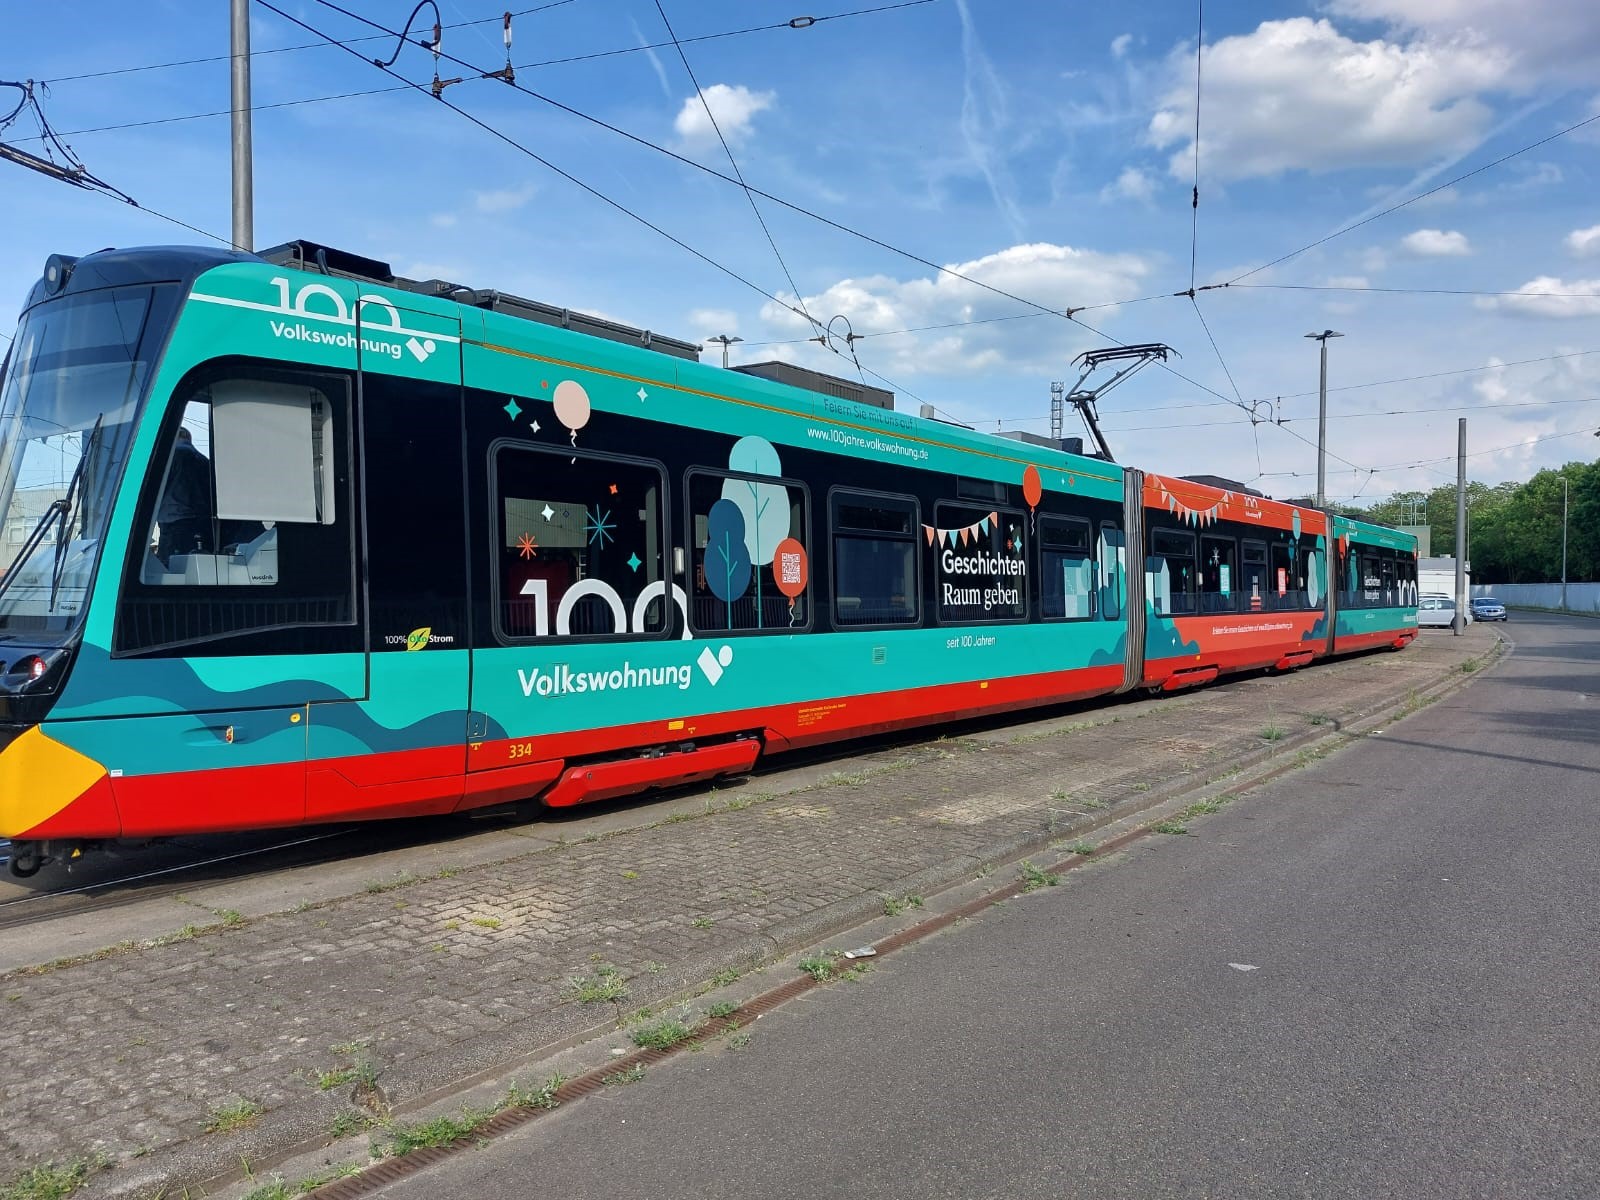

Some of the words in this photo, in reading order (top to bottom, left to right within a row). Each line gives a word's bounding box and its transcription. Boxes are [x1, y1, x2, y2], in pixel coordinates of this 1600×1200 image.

[270, 277, 401, 331] 100
[269, 320, 402, 360] Volkswohnung
[823, 398, 853, 417] Feiern
[853, 404, 867, 420] Sie
[869, 408, 883, 424] mit
[884, 414, 899, 428] uns
[900, 417, 914, 431] auf
[807, 427, 929, 461] www.100jahre.volkswohnung.de
[942, 549, 1026, 577] Geschichten
[519, 578, 694, 641] 100
[942, 582, 982, 606] Raum
[984, 581, 1019, 611] geben
[384, 635, 408, 645] 100%
[946, 635, 960, 649] seit
[961, 635, 973, 648] 100
[973, 634, 996, 647] Jahren
[517, 661, 692, 697] Volkswohnung
[508, 743, 533, 759] 334
